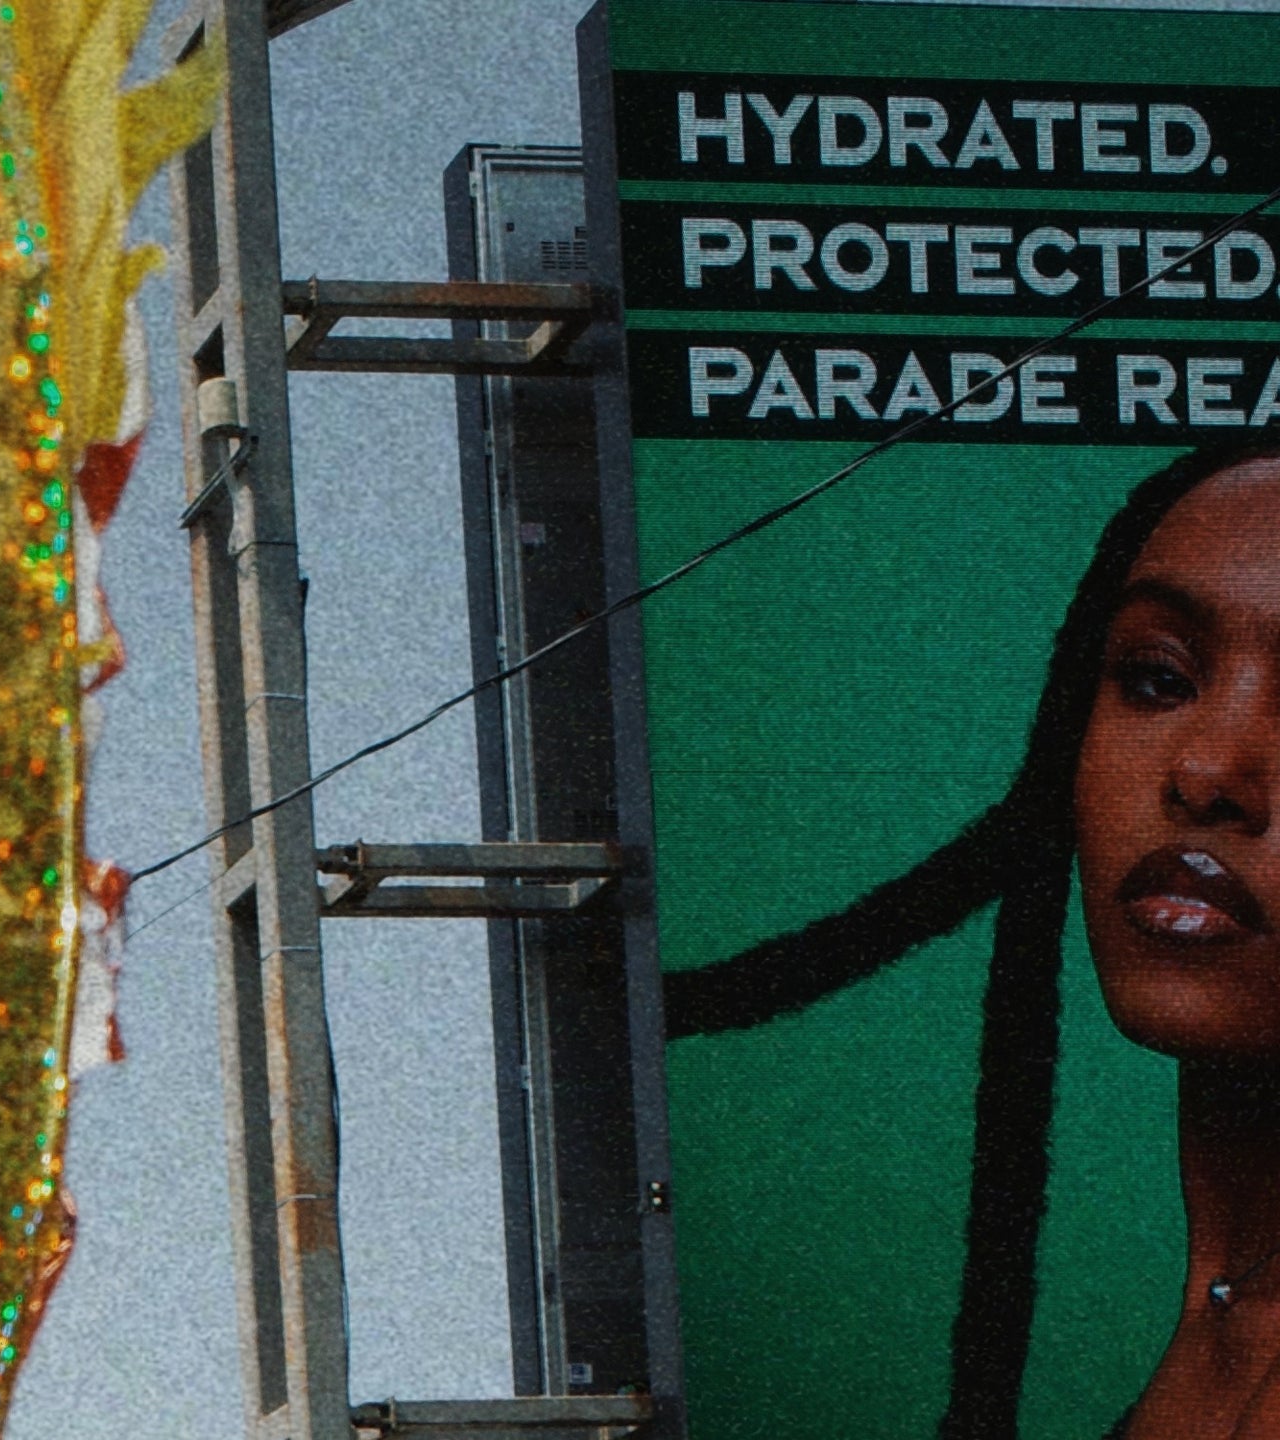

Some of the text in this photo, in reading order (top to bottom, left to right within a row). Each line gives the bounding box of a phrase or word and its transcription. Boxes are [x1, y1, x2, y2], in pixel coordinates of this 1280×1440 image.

[676, 91, 1228, 174] HYDRATED.
[680, 217, 1280, 301] PROTECTED
[687, 345, 1080, 425] PARADE
